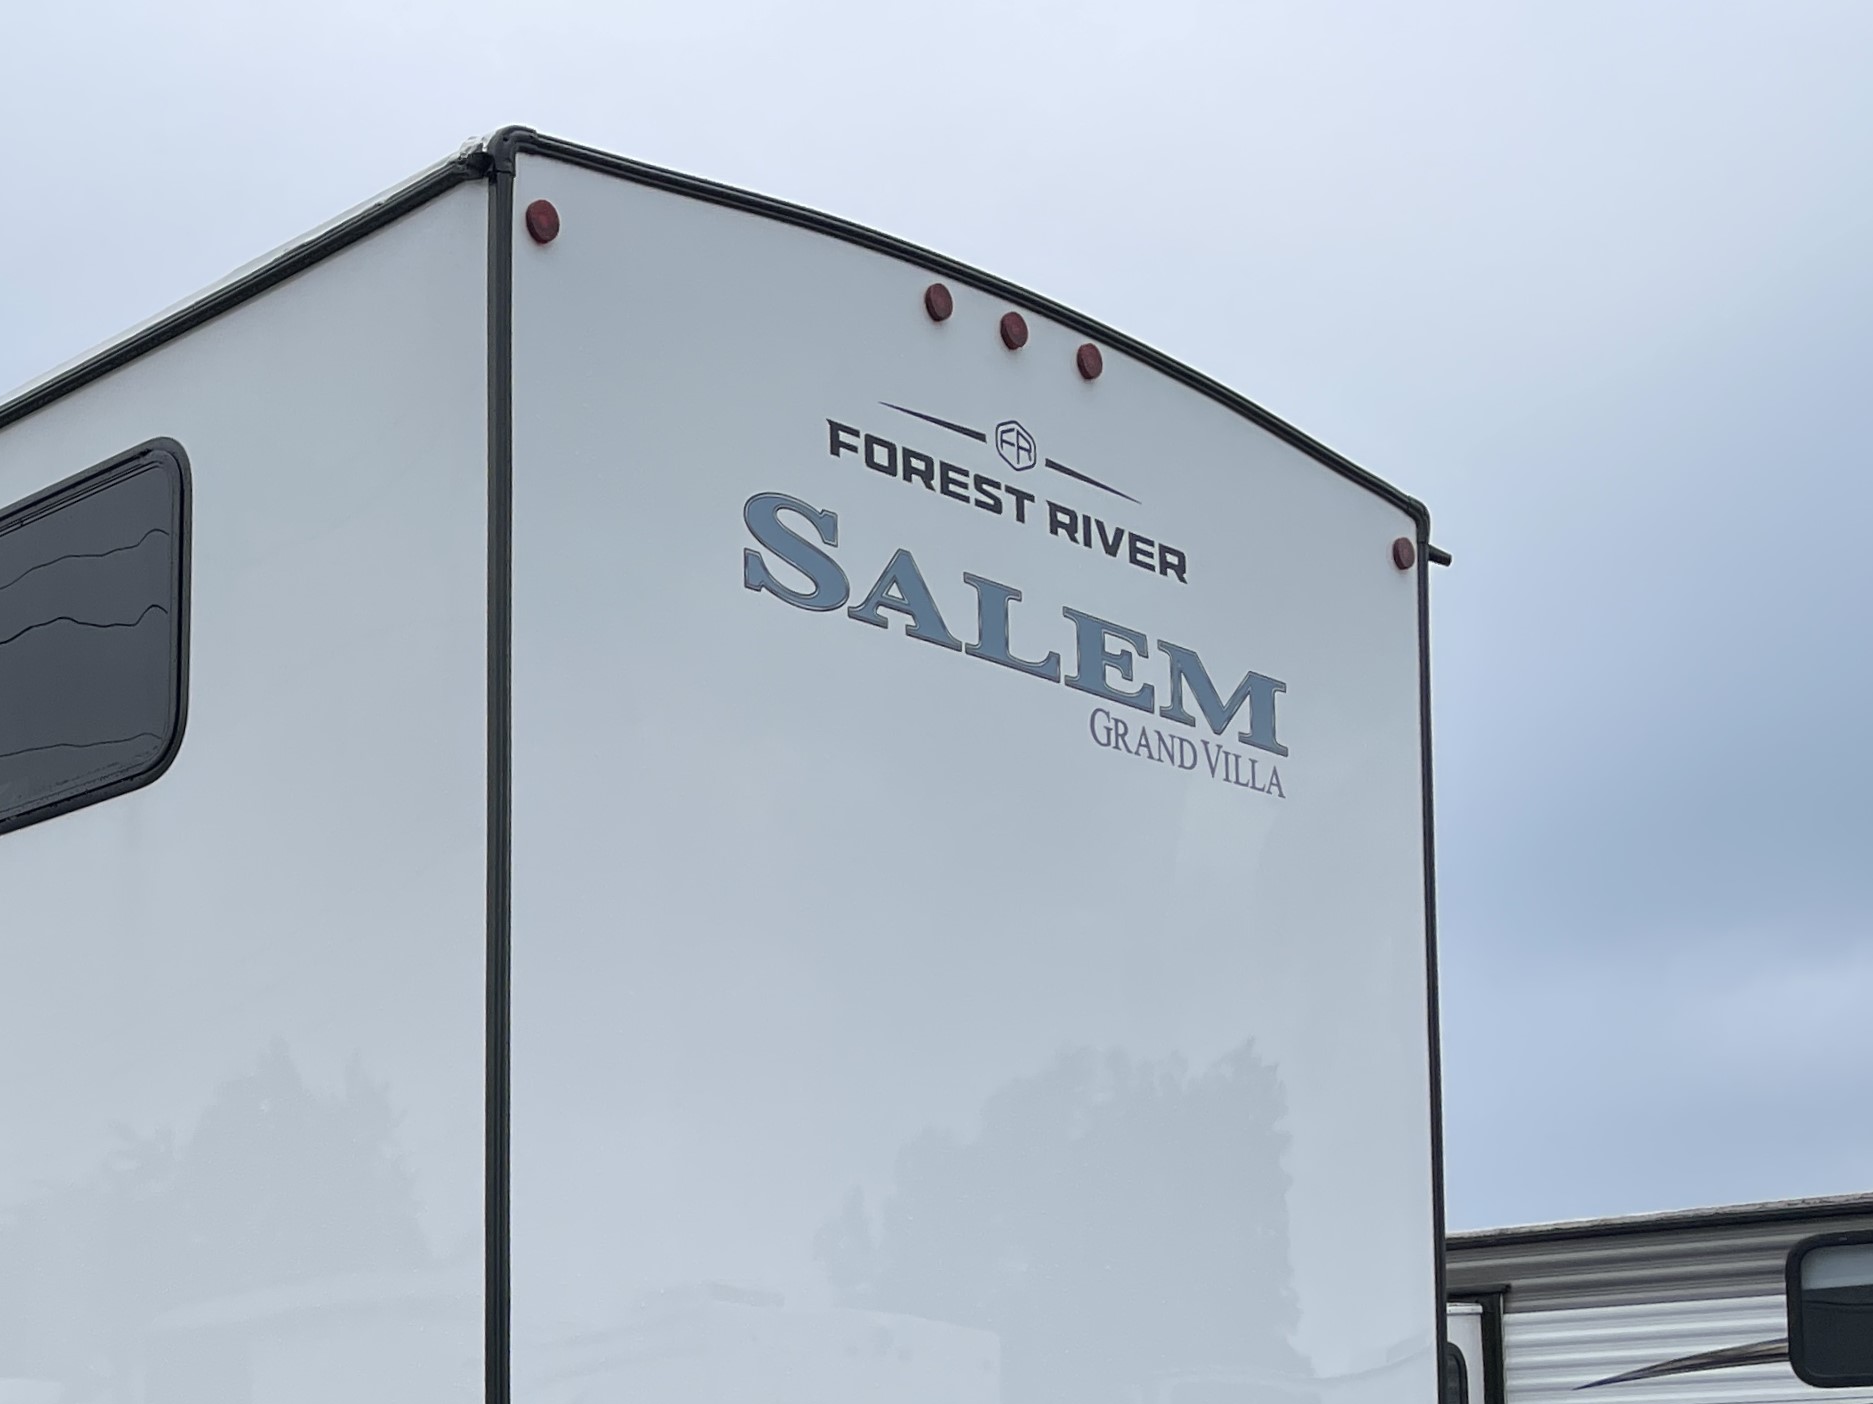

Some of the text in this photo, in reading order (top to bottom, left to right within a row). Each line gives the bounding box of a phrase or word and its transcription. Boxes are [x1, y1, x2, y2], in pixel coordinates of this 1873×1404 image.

[826, 418, 1188, 585] FOREST RIVER
[743, 491, 1289, 757] SALEM
[1088, 707, 1287, 799] GRAND VILLA
